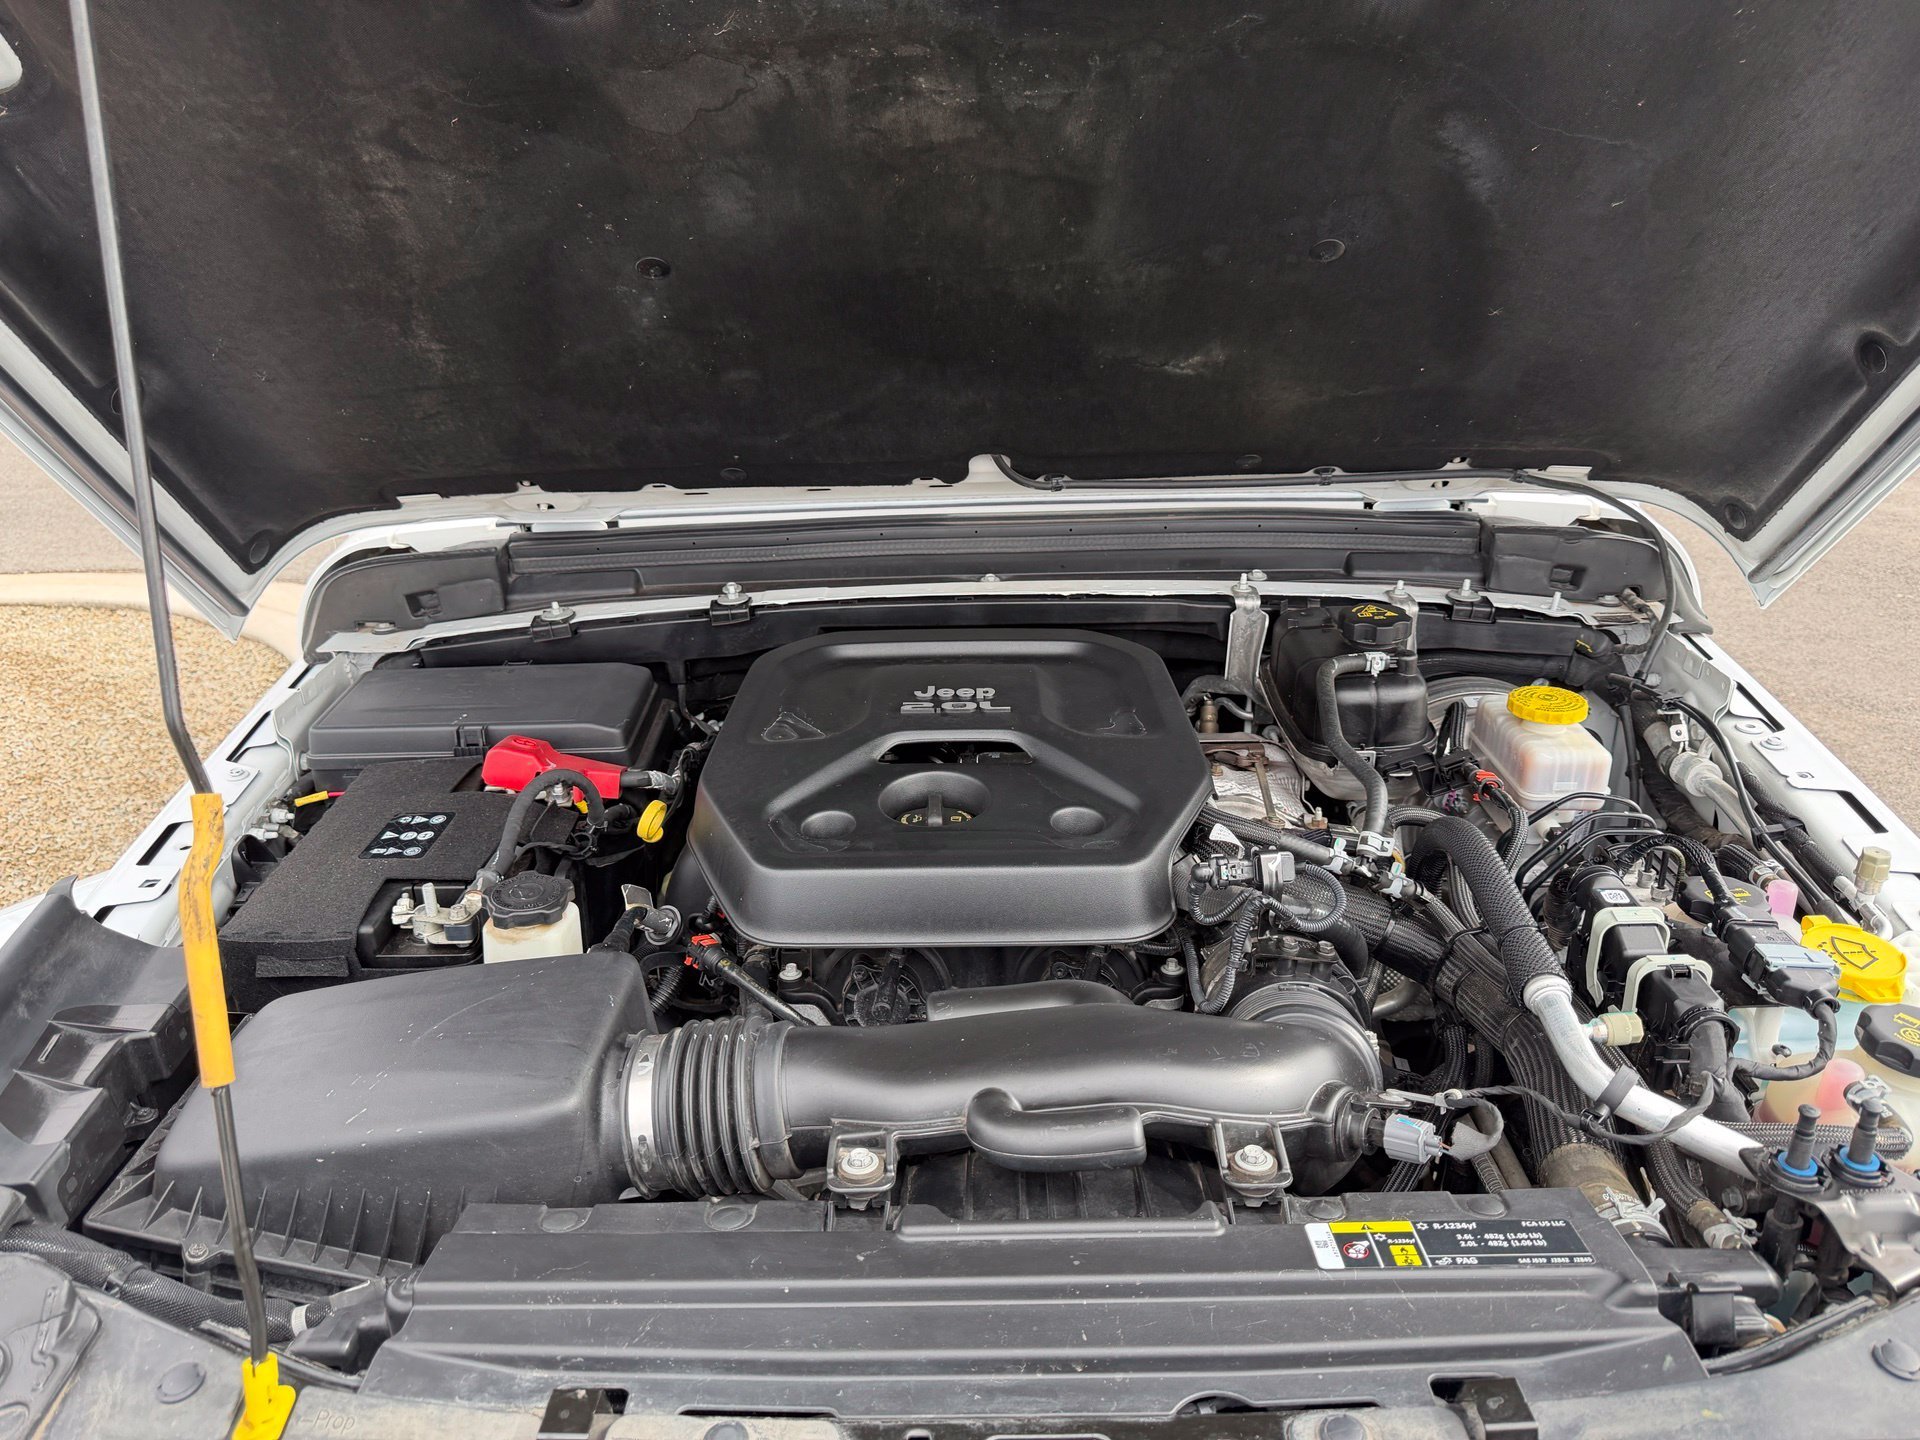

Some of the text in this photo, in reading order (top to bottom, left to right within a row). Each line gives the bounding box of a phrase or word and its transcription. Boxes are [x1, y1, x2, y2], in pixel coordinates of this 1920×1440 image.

[913, 685, 996, 700] Jeep
[900, 700, 1012, 714] 2.0L
[1432, 1222, 1477, 1230] R-1234yf
[1456, 1256, 1479, 1265] PAG
